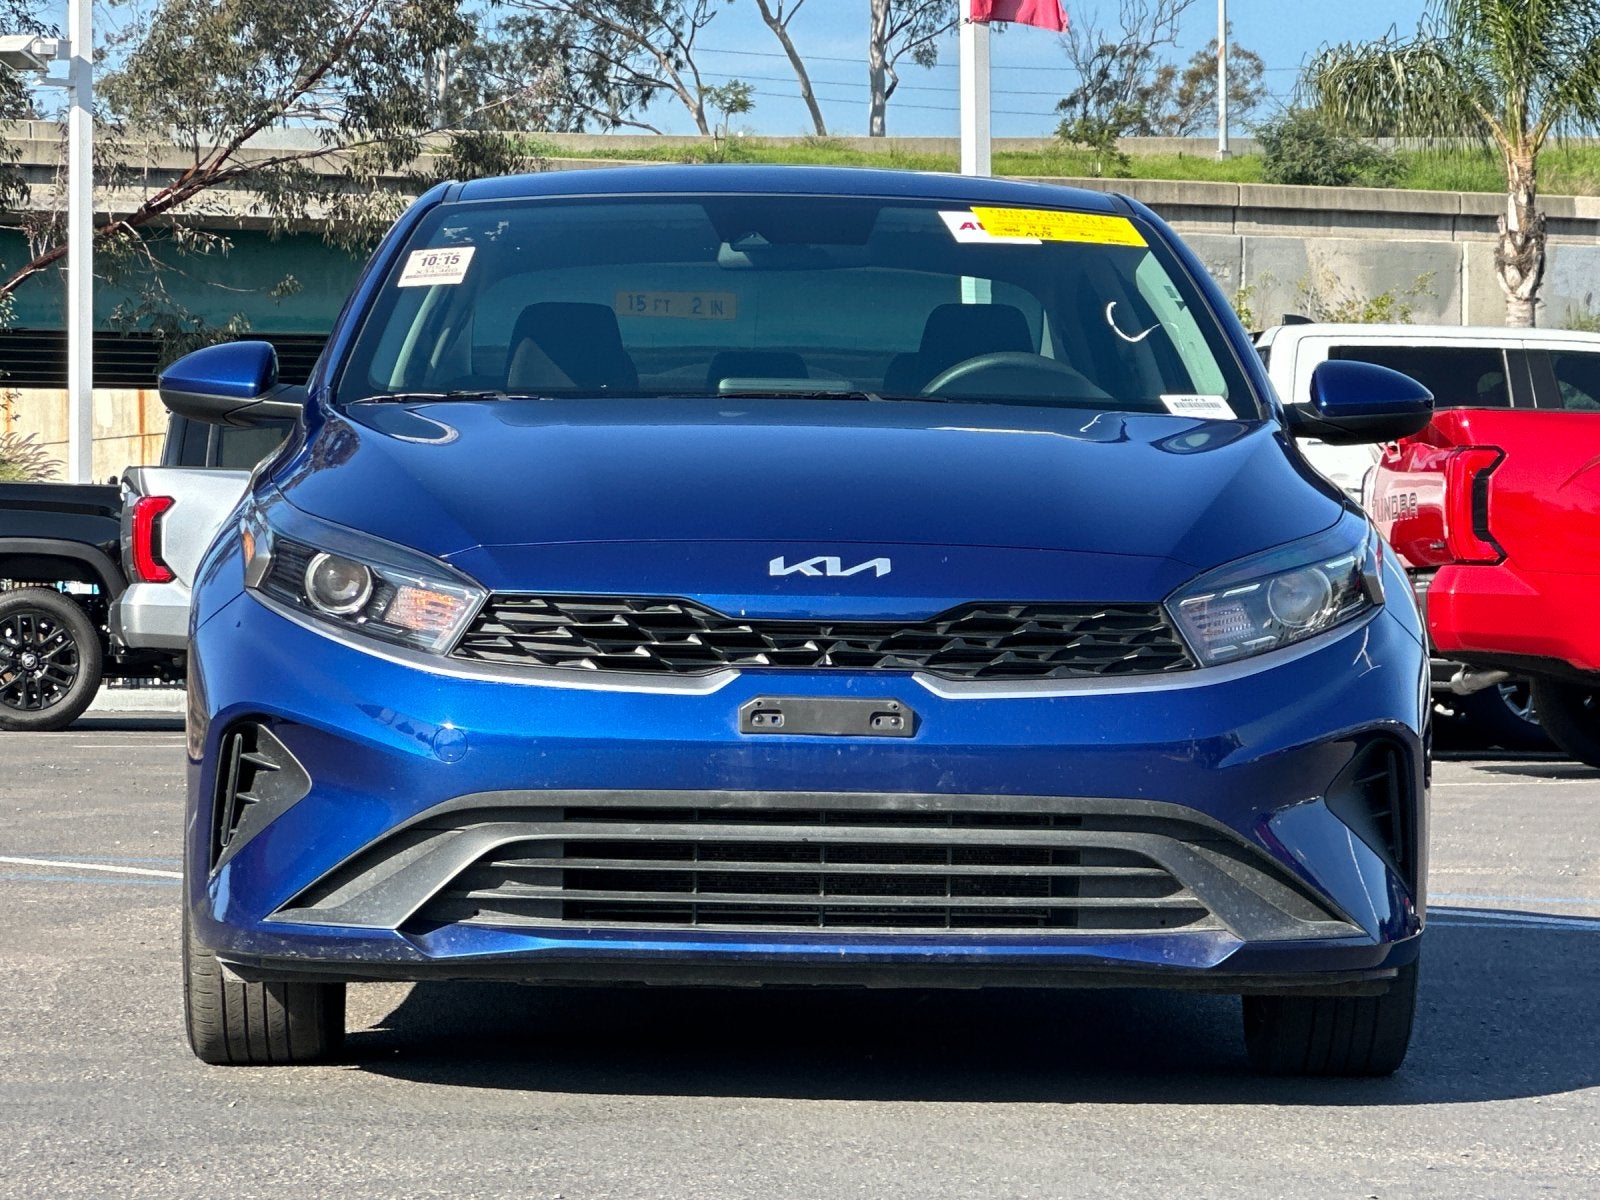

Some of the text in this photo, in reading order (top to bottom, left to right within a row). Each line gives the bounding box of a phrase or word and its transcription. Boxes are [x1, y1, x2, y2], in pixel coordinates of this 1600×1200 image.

[421, 255, 461, 267] 10:15
[628, 294, 724, 315] 15 FT 2 IN
[769, 555, 892, 577] KIA
